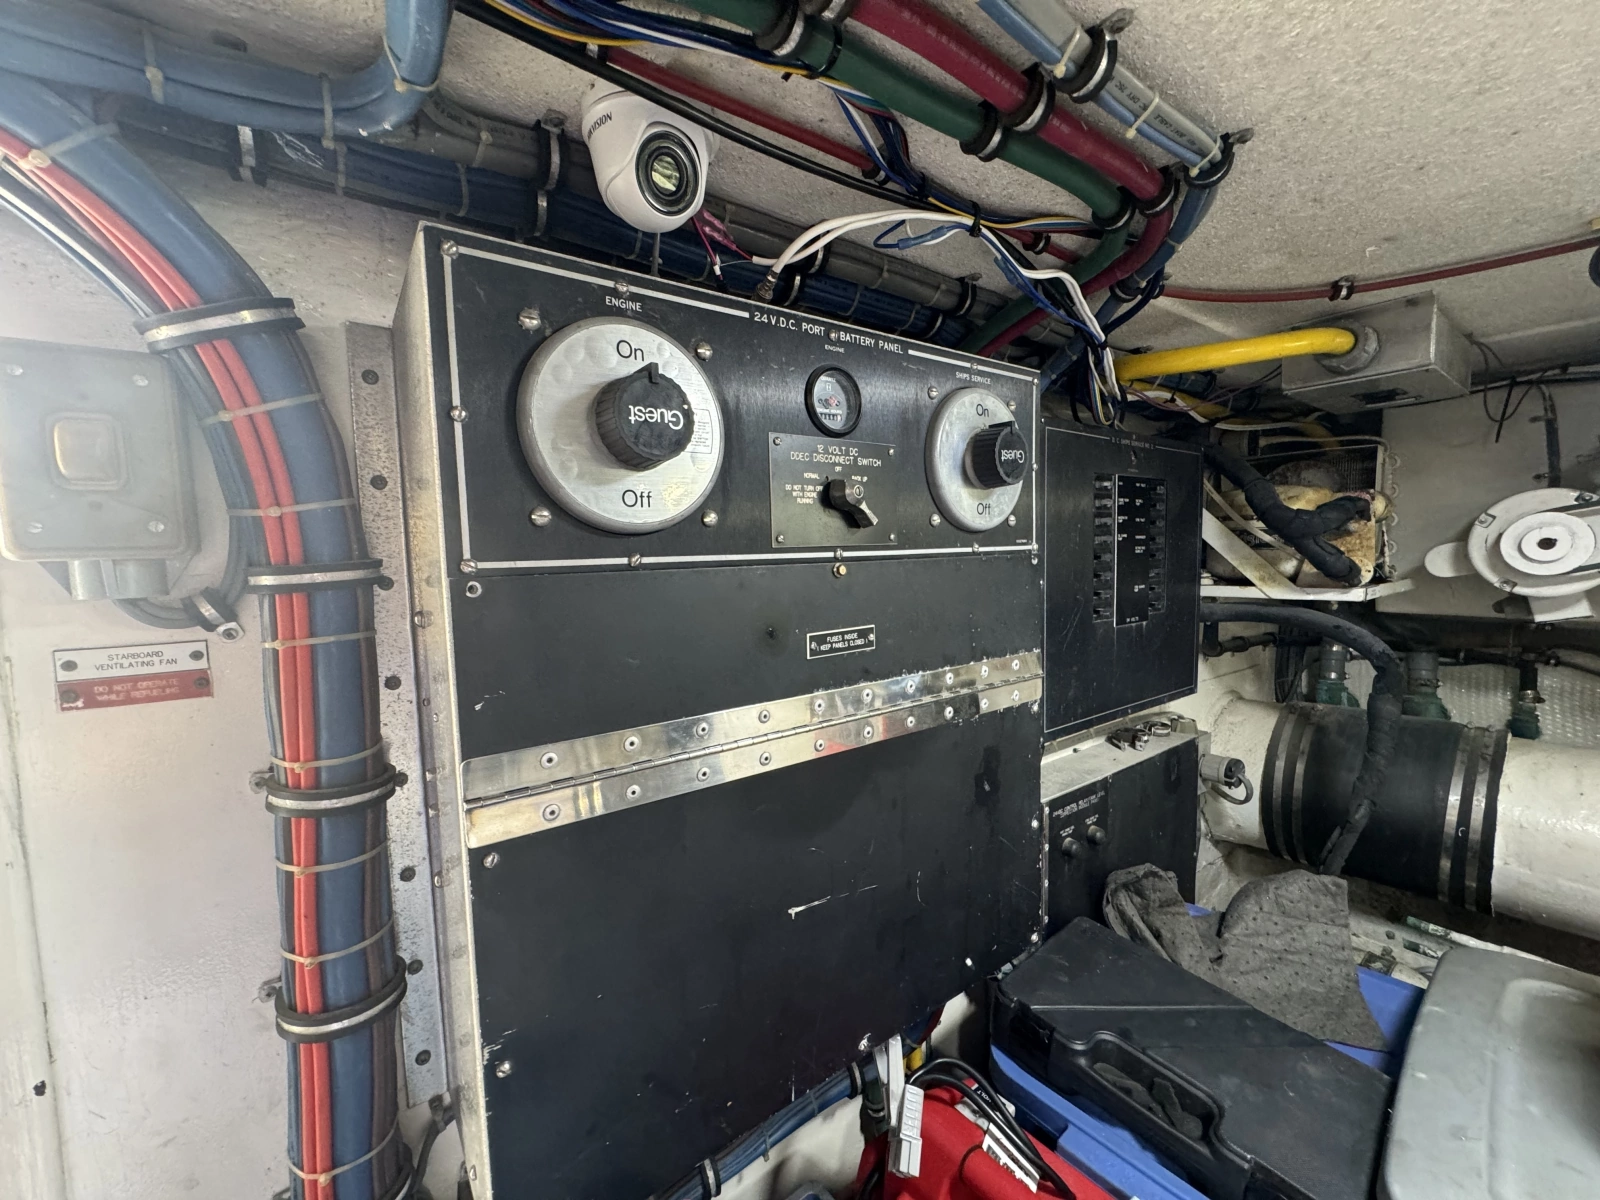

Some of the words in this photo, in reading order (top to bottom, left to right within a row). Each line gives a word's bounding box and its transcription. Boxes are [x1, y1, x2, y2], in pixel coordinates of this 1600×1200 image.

[605, 296, 642, 312] ENGINE
[754, 312, 768, 324] 24
[802, 322, 826, 337] PORT
[839, 331, 876, 348] BATTERY
[878, 340, 904, 355] PANEL
[616, 339, 645, 361] On
[824, 344, 845, 354] ENGINE
[955, 372, 970, 381] SHIPS
[971, 374, 991, 385] SERVICE
[628, 405, 684, 431] Guest
[976, 403, 990, 418] On
[817, 444, 824, 453] 12
[828, 446, 846, 455] VOLT
[849, 448, 859, 457] DC
[1001, 449, 1025, 464] Guest
[790, 451, 809, 461] DDEC
[813, 453, 854, 465] DISCONNECT
[857, 458, 882, 467] SWITCH
[622, 489, 653, 508] Off
[976, 503, 991, 516] Off
[826, 634, 843, 643] FUSES
[844, 632, 859, 640] INSIDE
[832, 640, 849, 649] PANELS
[107, 650, 164, 662] STARBOARD
[94, 660, 155, 671] VENTILATING
[159, 658, 178, 666] FAN
[93, 685, 109, 694] DO
[113, 682, 132, 691] NOT
[137, 678, 180, 689] OPERATE
[95, 691, 127, 701] WHILE
[130, 686, 181, 699] REFUELING
